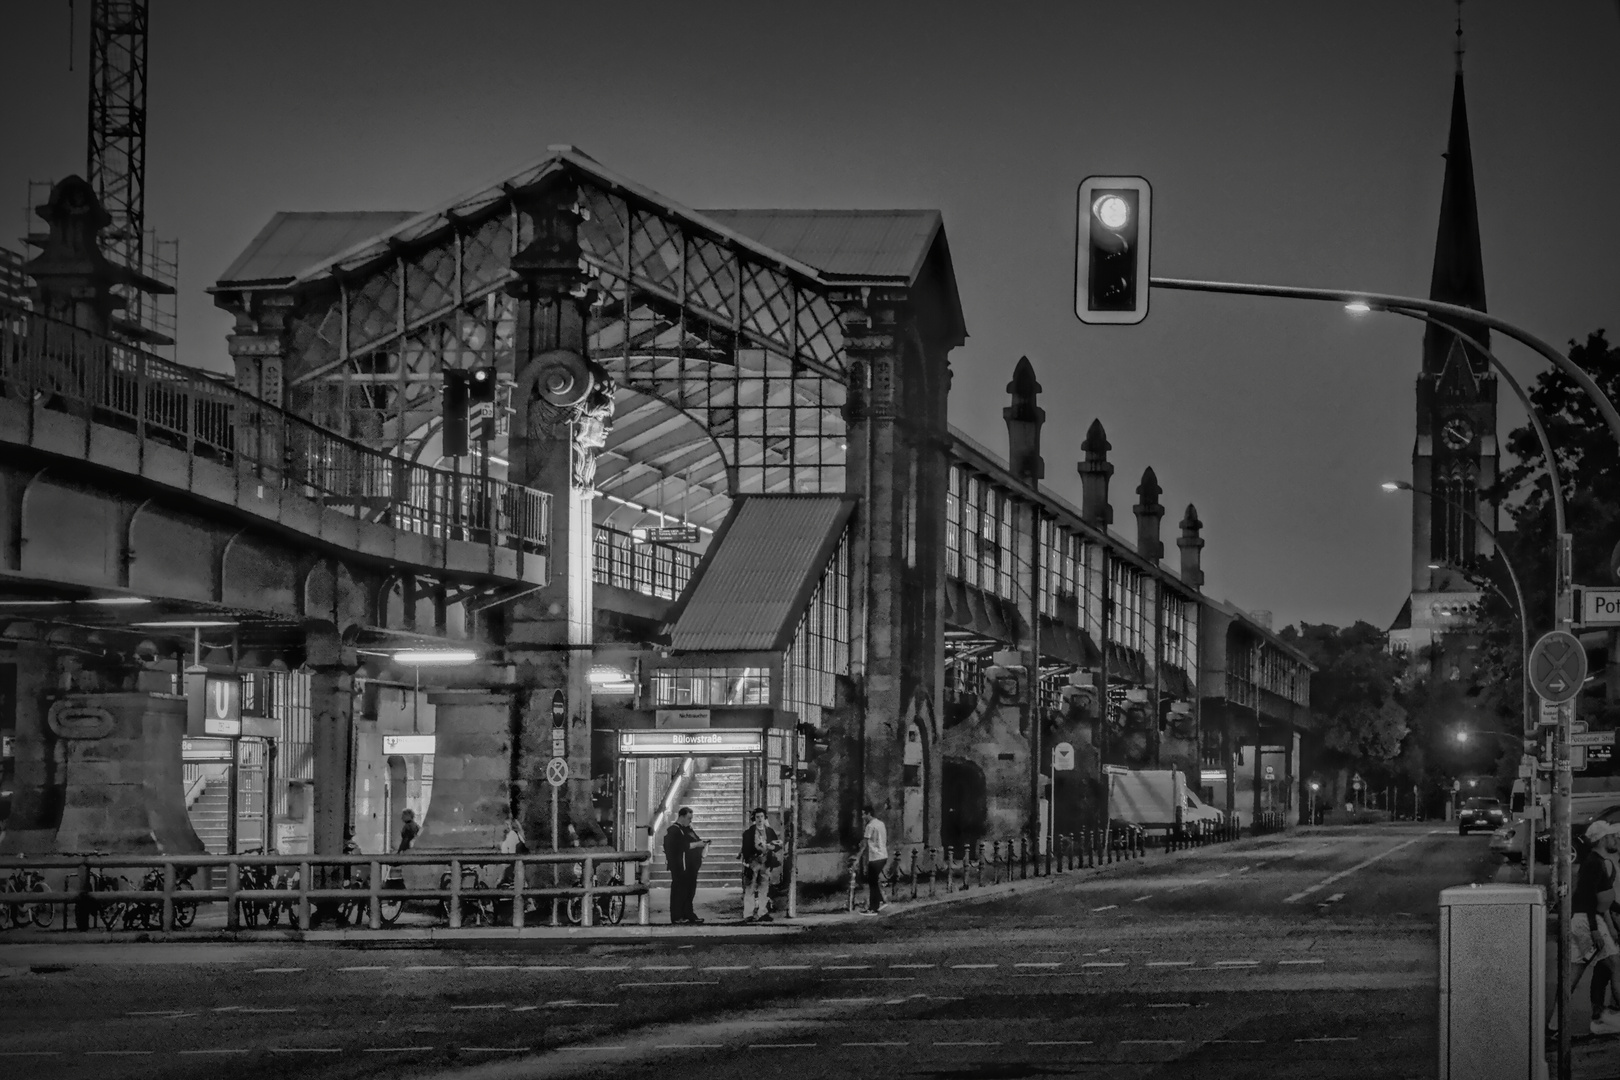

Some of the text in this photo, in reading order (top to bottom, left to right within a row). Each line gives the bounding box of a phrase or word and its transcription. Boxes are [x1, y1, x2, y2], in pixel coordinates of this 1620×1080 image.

[215, 681, 230, 719] U
[622, 733, 633, 745] U
[672, 734, 723, 744] Bülowstraße
